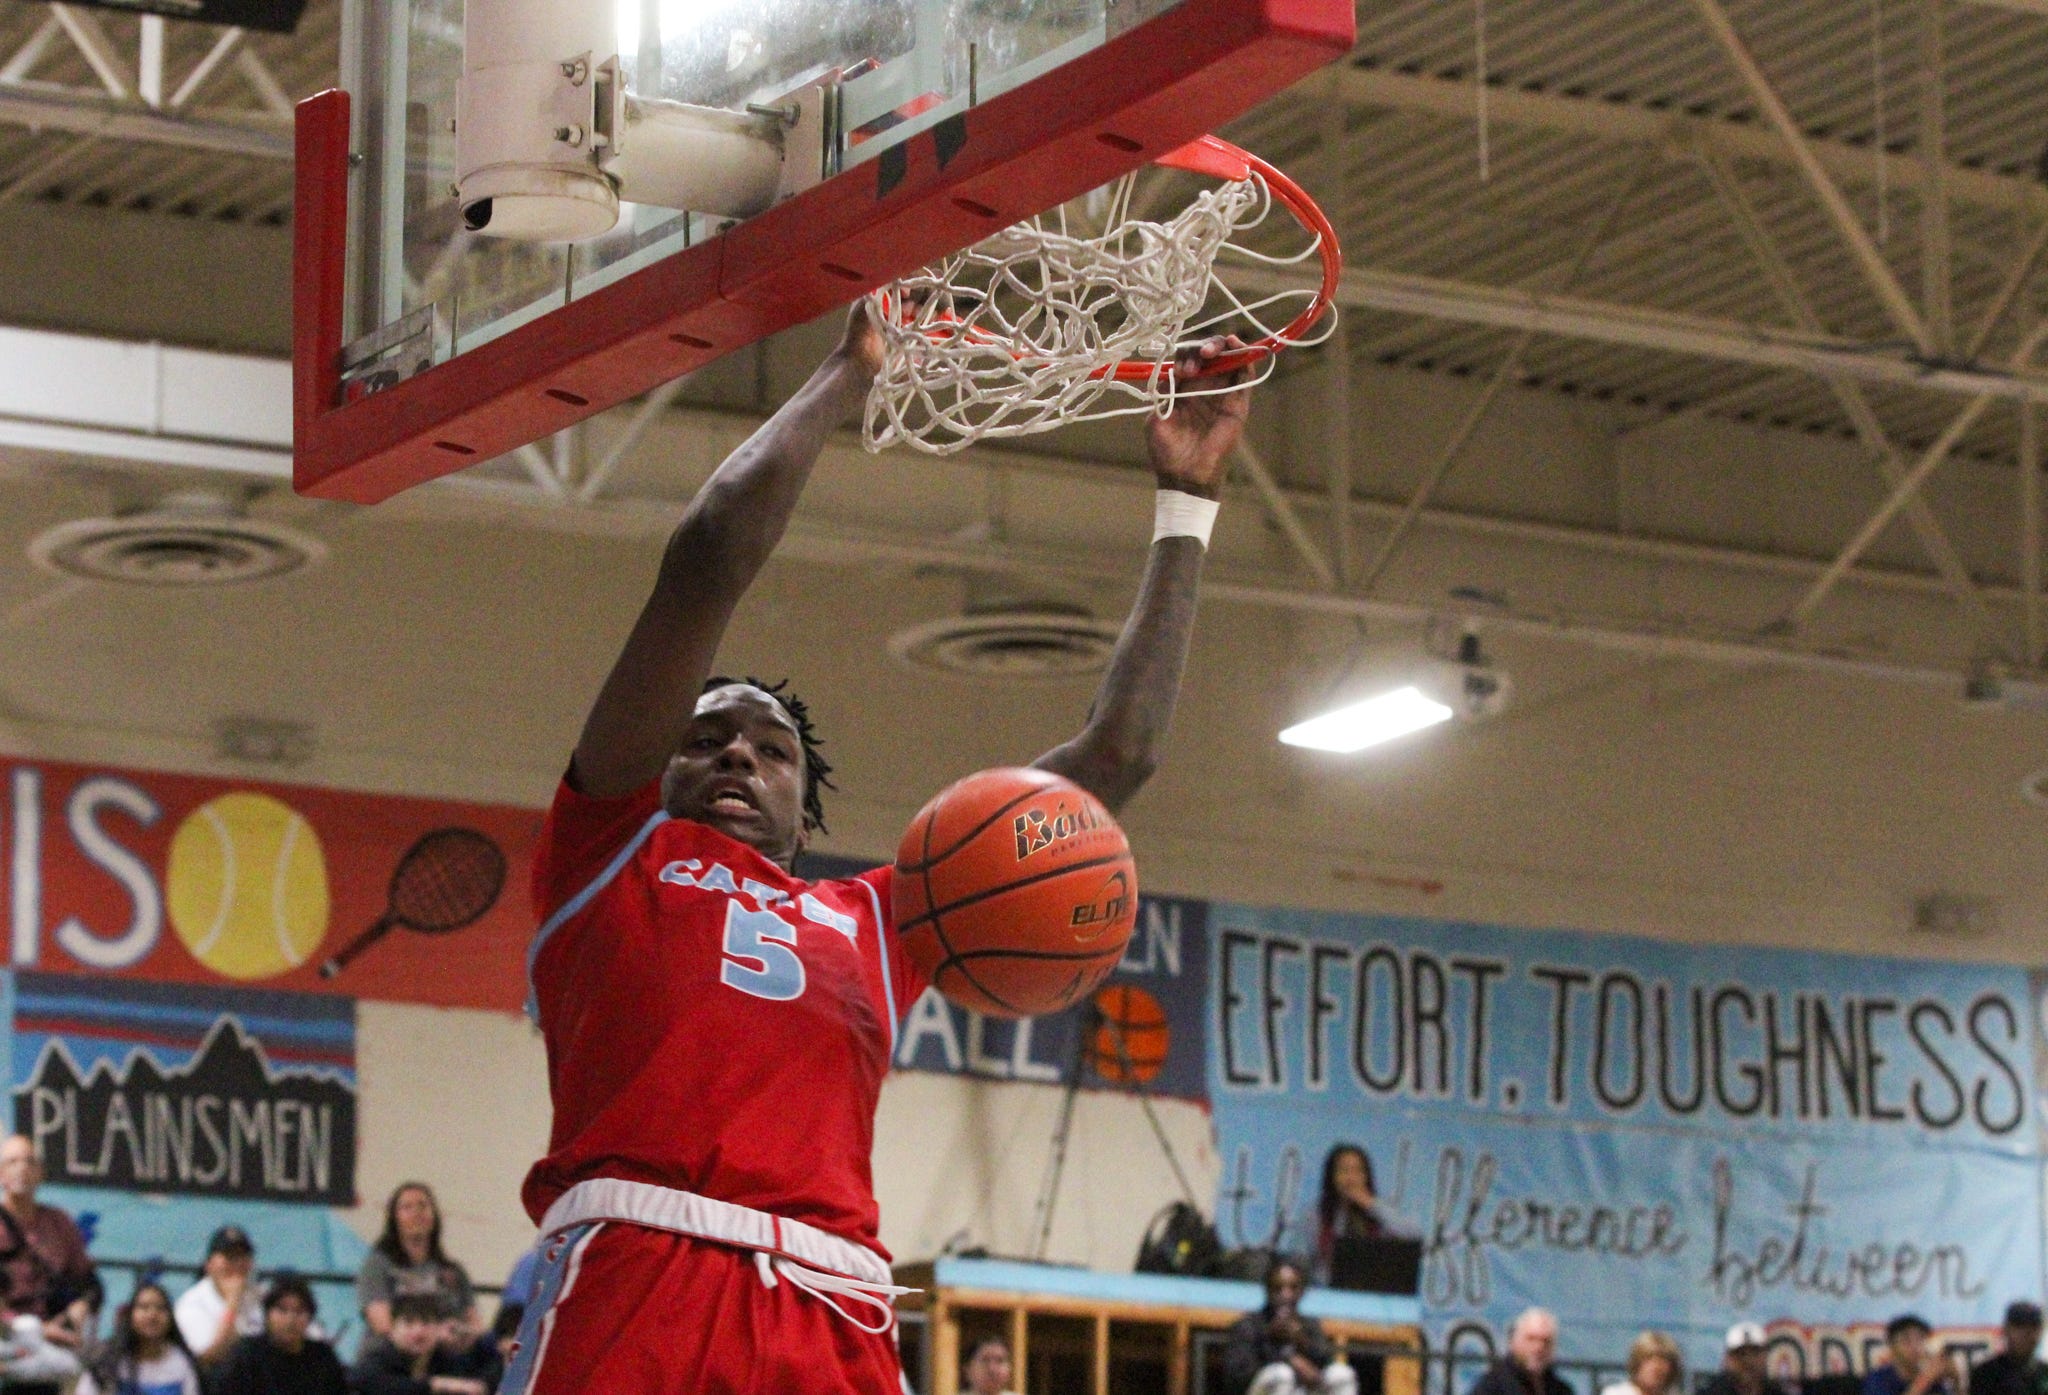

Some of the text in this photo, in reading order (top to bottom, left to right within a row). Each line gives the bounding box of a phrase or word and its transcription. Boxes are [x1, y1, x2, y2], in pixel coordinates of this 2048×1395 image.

[12, 768, 160, 967] IS
[720, 898, 806, 1001] 5
[1532, 964, 2028, 1136] TOUGHNESS
[32, 1088, 333, 1191] PLAINSMEN
[1705, 1156, 1988, 1308] between
